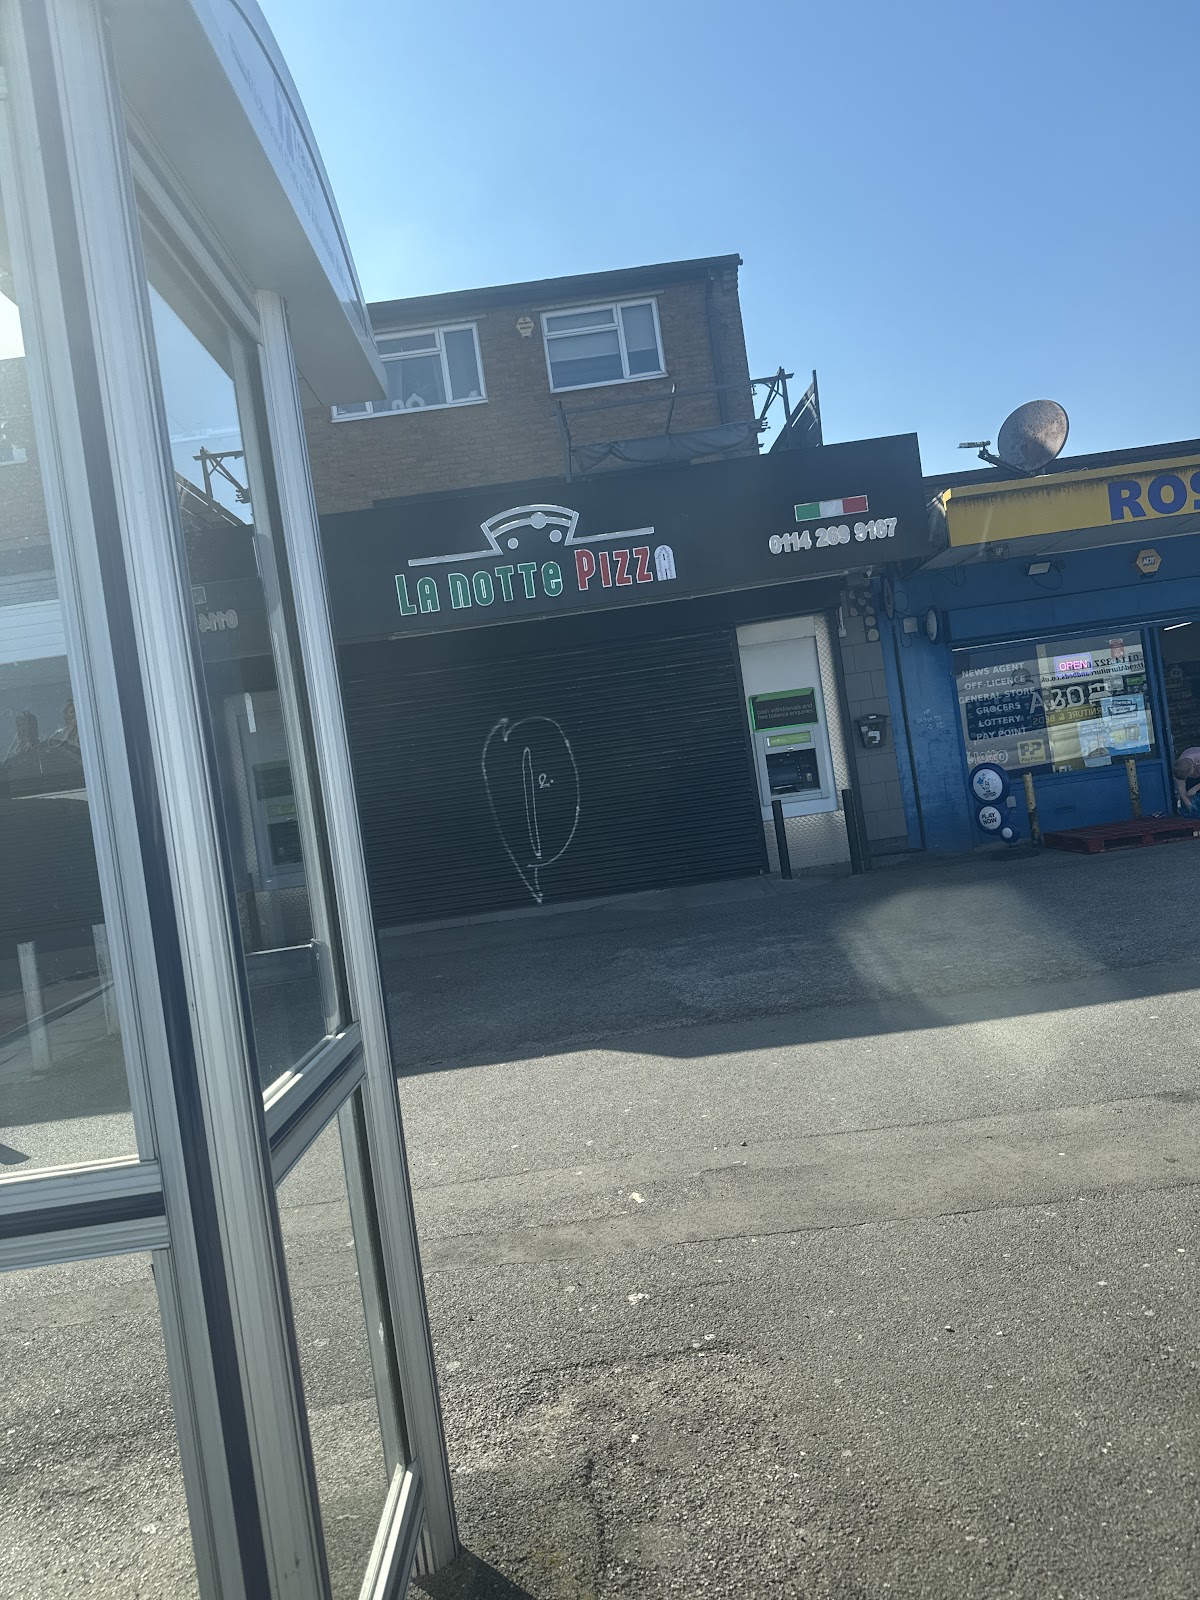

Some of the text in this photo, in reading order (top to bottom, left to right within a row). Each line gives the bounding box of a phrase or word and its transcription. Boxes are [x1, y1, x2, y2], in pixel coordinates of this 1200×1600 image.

[769, 530, 812, 554] 0114
[815, 525, 850, 547] 269
[574, 544, 677, 591] PIZZA
[961, 662, 1025, 678] NEWS AGENT
[1059, 660, 1088, 671] OPEN
[964, 675, 1026, 691] OFF-LICENCE
[958, 687, 1036, 704] GENERAL STORE
[769, 711, 789, 719] balance
[790, 708, 813, 717] enquiries
[771, 704, 801, 713] withdrawals
[976, 702, 1021, 715] GROCERS
[978, 715, 1021, 728] LOTTERY
[976, 727, 1027, 741] PAY POINT
